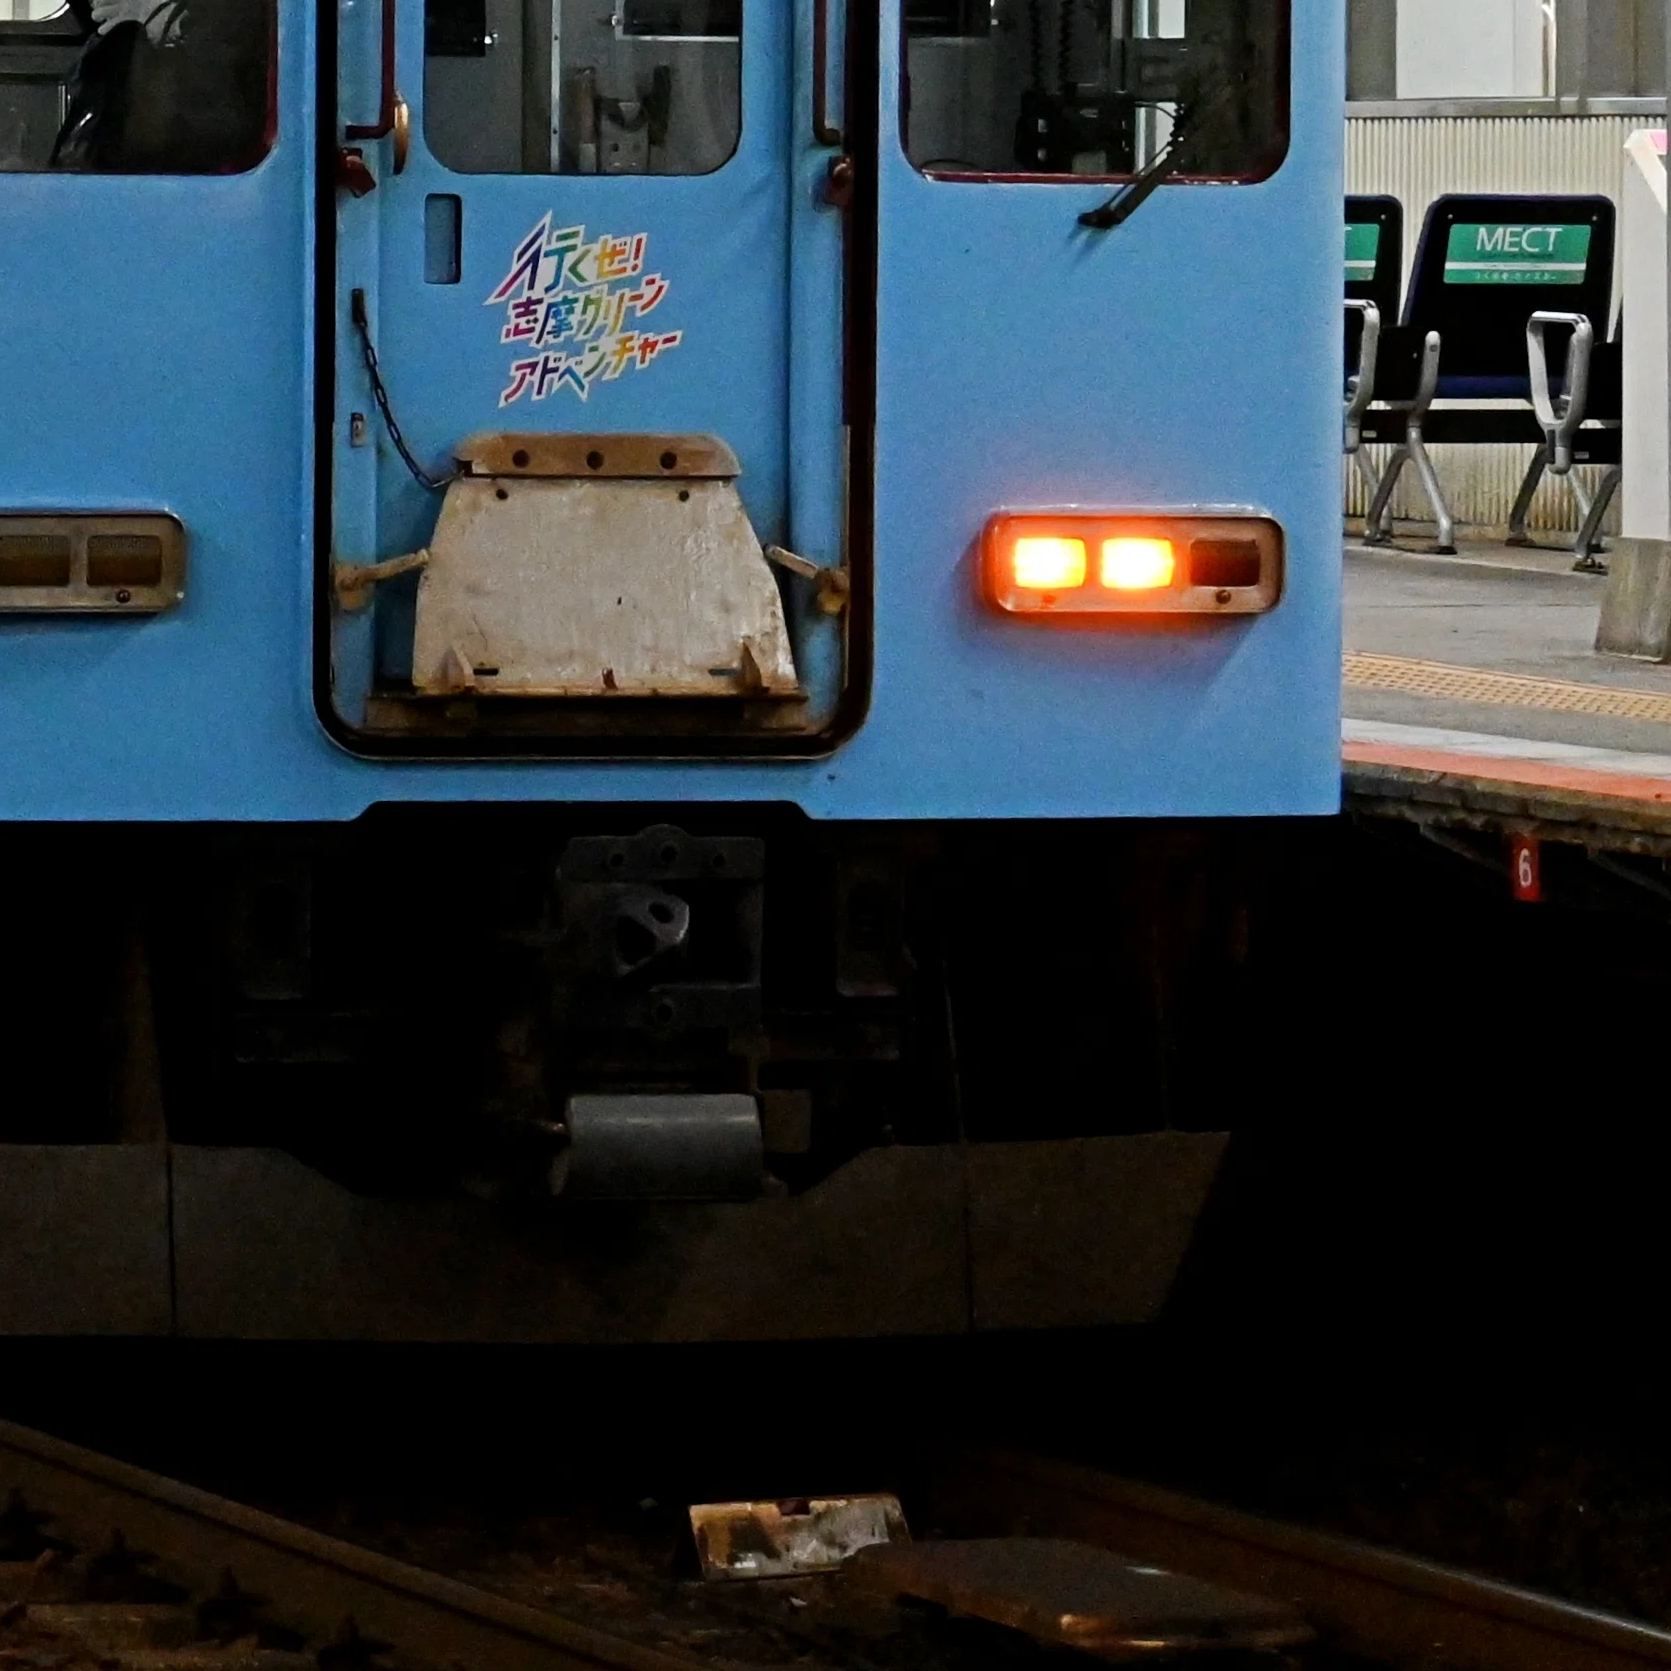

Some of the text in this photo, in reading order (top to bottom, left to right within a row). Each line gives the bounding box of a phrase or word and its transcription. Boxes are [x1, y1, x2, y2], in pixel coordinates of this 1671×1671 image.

[1475, 226, 1564, 253] MECT
[502, 274, 668, 348] 志摩グリーン
[500, 332, 681, 406] アドベンチャー
[1517, 848, 1532, 887] 6
